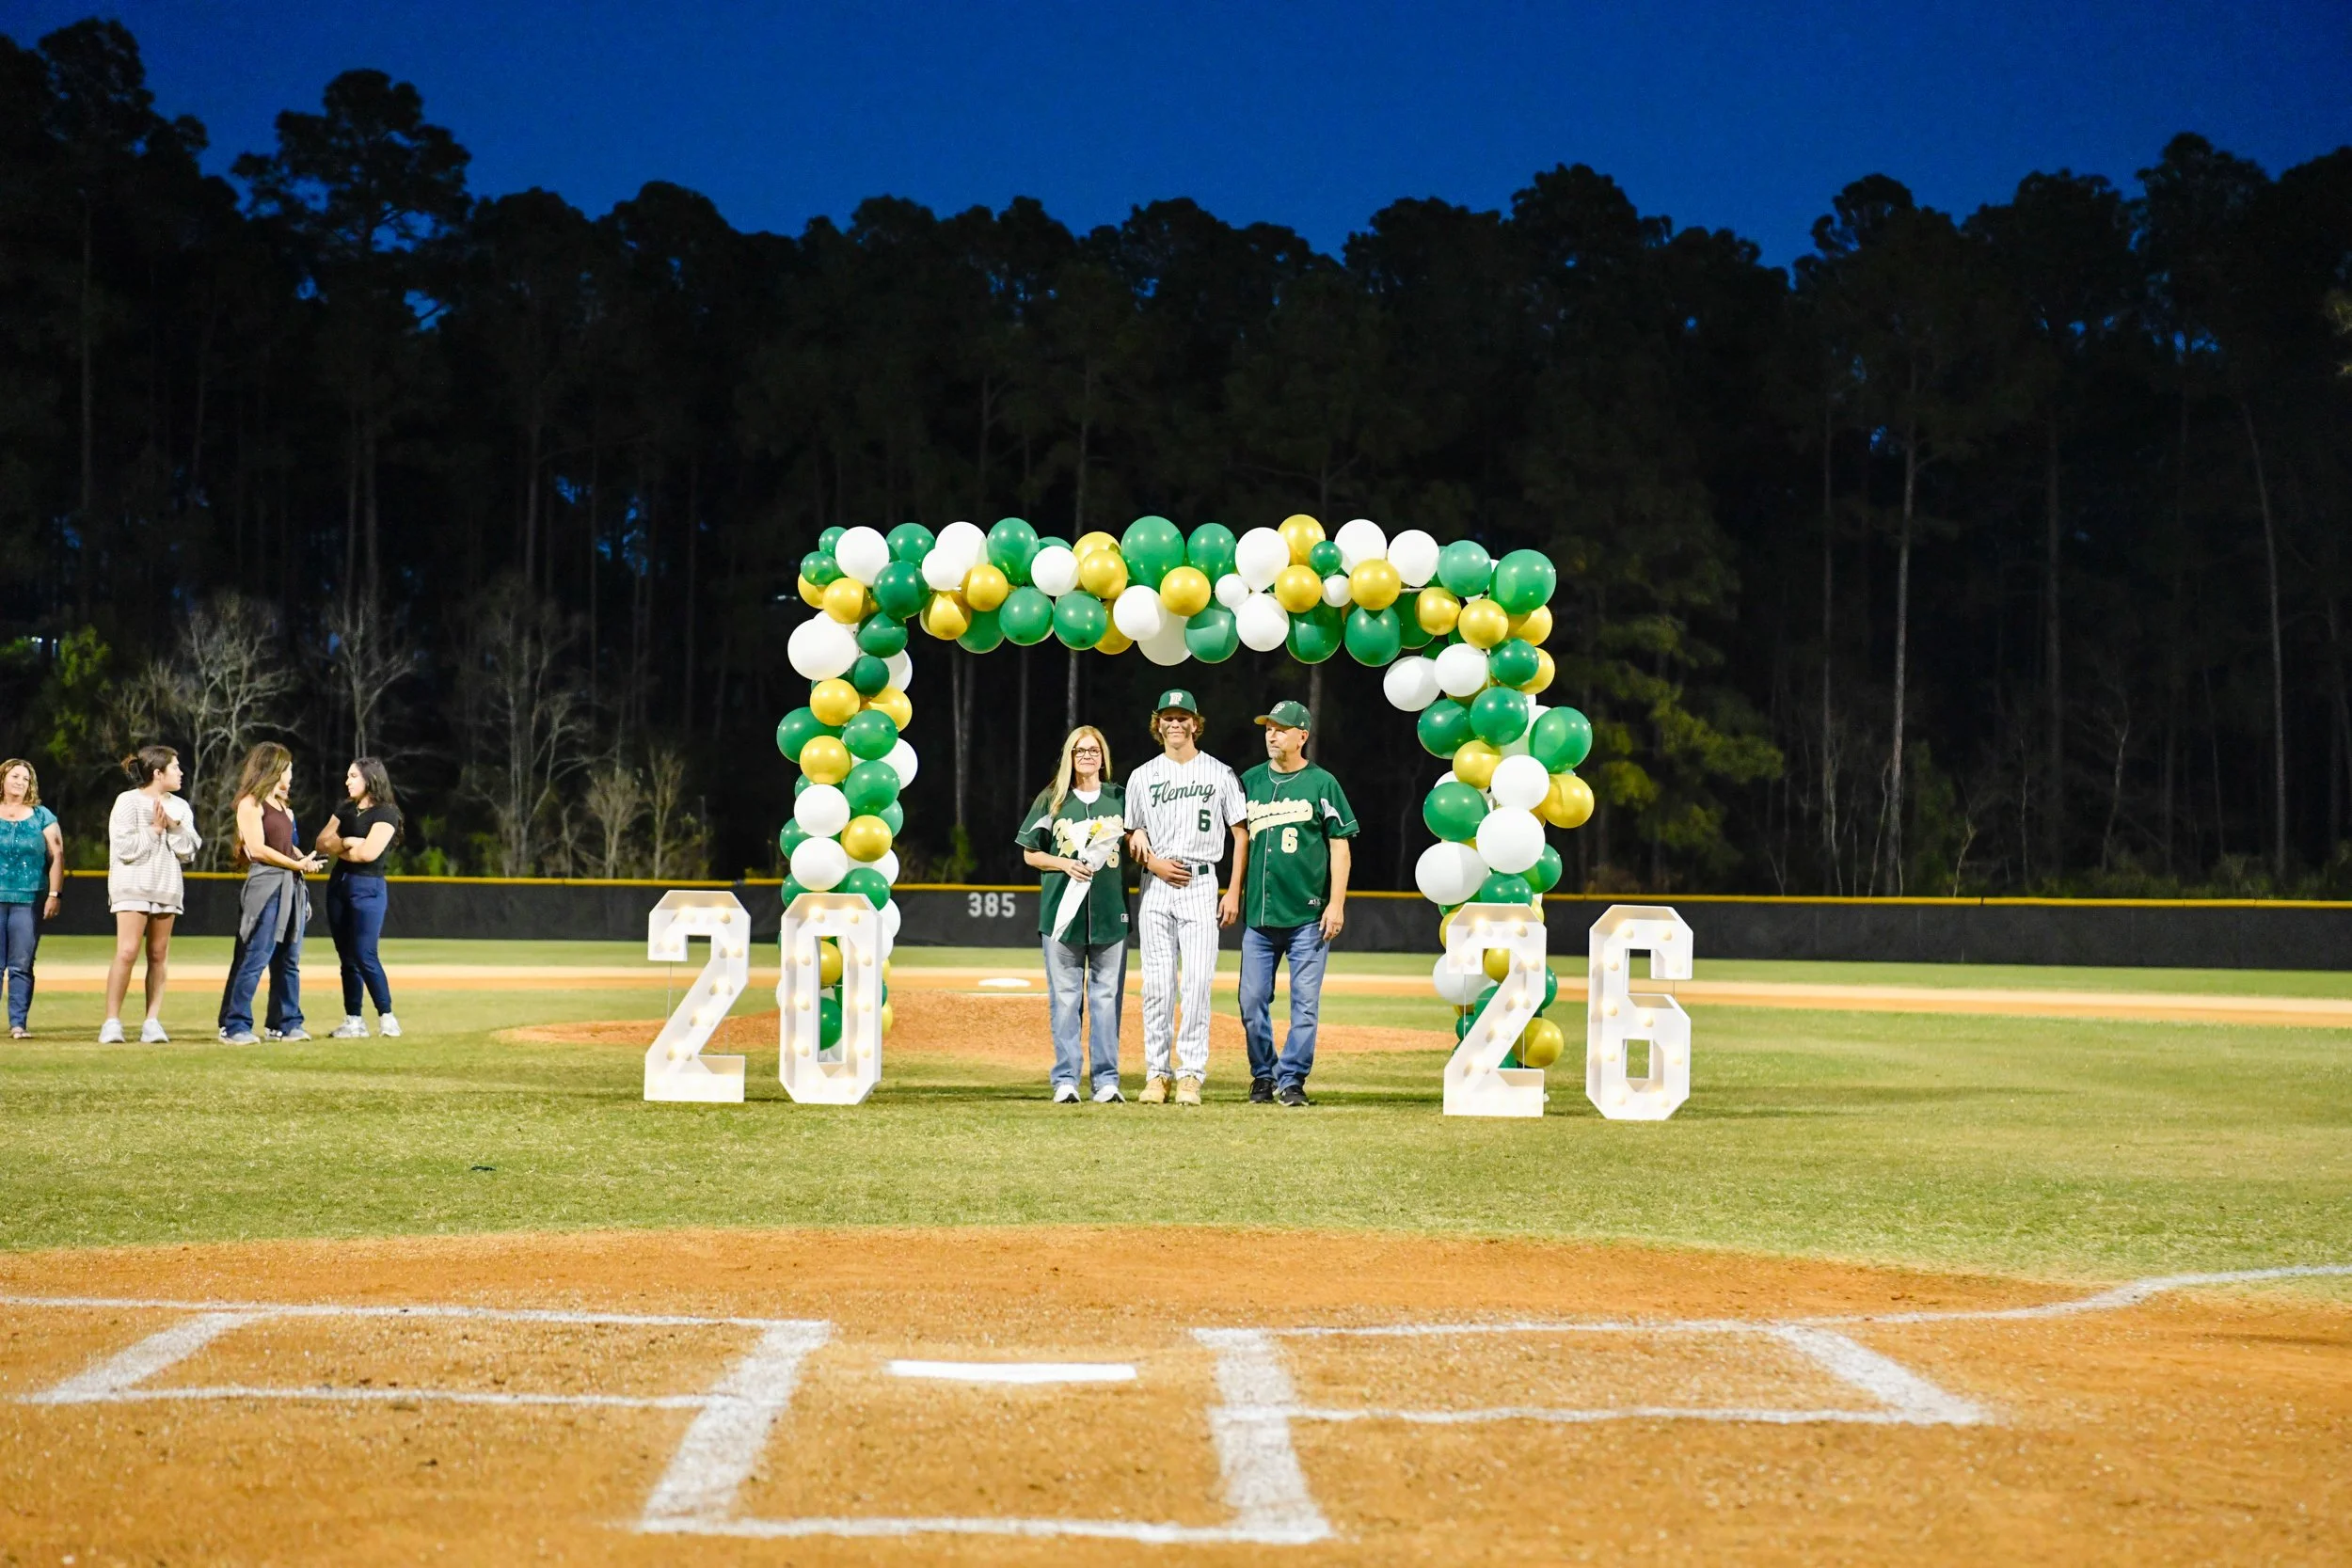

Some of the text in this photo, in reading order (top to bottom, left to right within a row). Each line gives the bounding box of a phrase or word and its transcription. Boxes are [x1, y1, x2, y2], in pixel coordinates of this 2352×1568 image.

[1150, 780, 1216, 808] Fleming
[1198, 809, 1211, 832] 6
[1280, 827, 1298, 854] 6
[1106, 842, 1120, 868] 6
[967, 892, 1016, 918] 385
